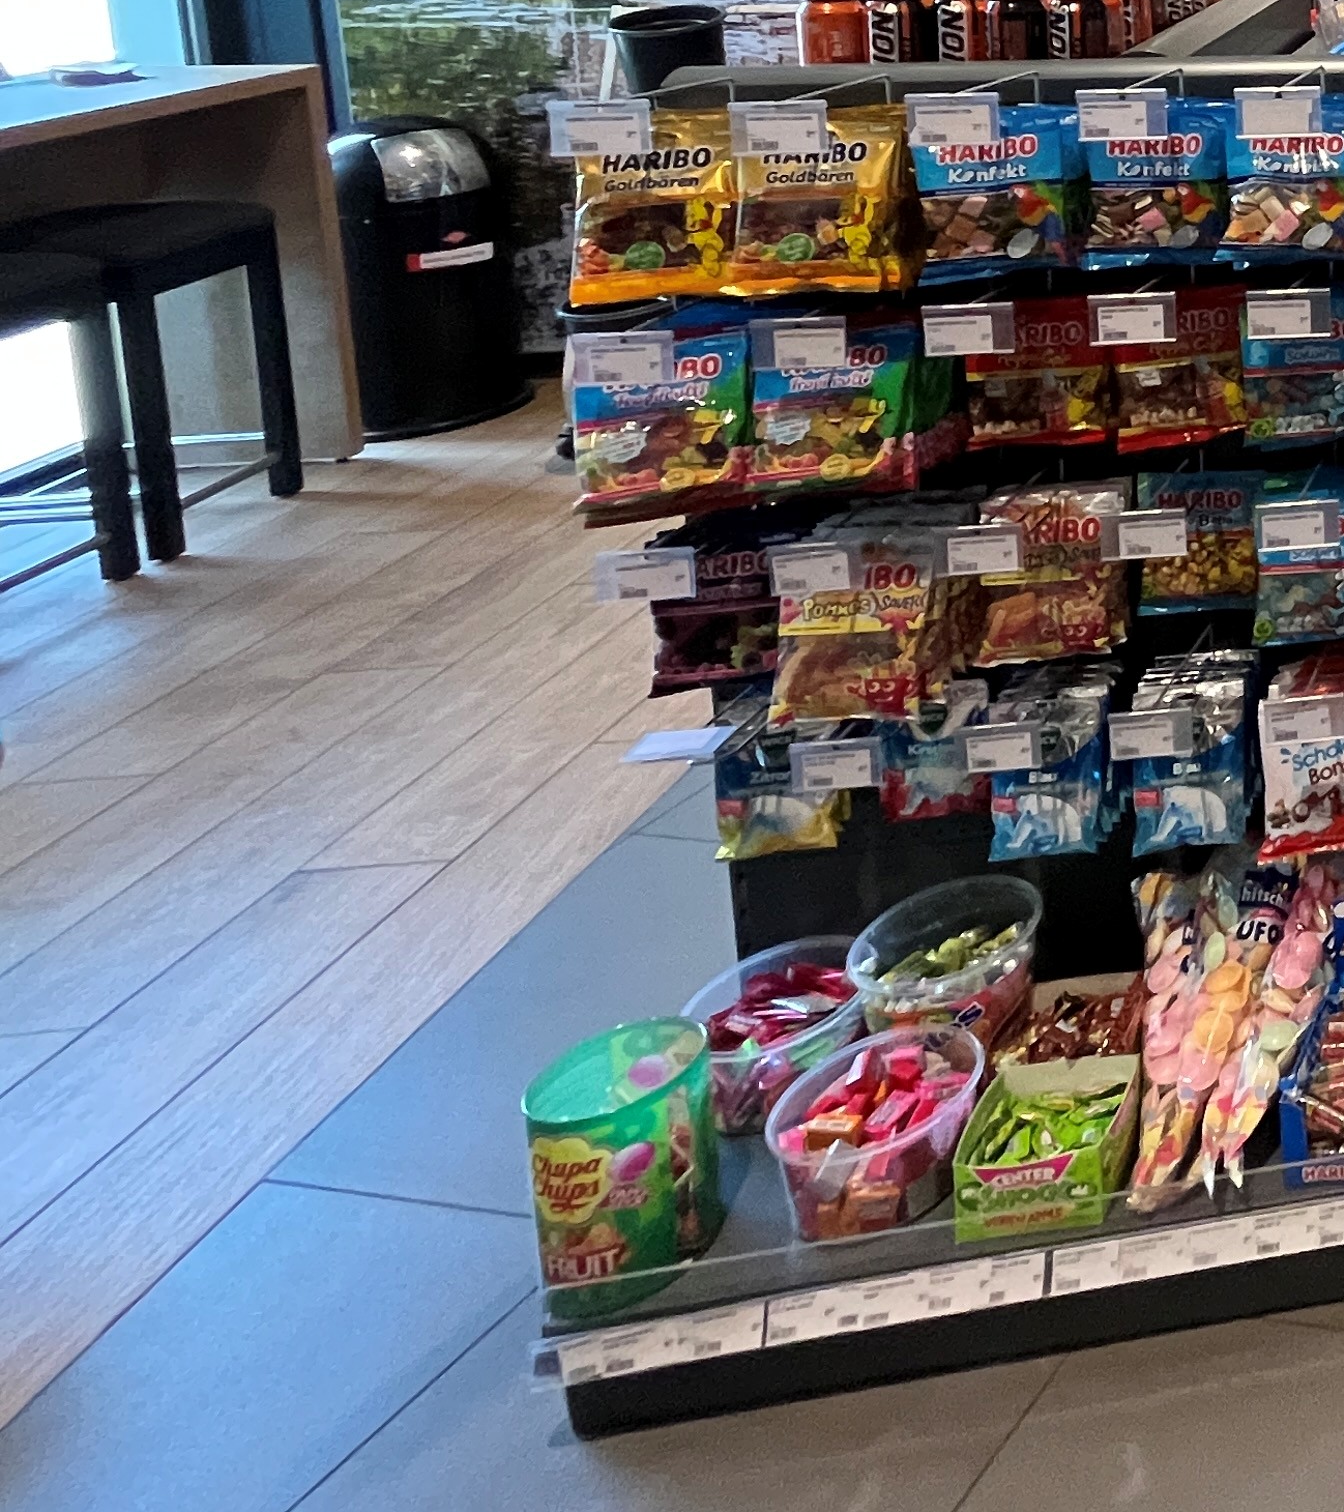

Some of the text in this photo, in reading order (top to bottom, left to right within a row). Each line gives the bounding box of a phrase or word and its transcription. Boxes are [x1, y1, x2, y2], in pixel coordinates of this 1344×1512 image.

[936, 133, 1038, 166] HARIBO
[1106, 133, 1203, 158] HARIBO
[602, 146, 712, 175] HARIBO
[946, 163, 1028, 185] Konfekt
[1115, 159, 1191, 179] Konfekt
[765, 170, 855, 185] Goldbären
[696, 550, 768, 580] ARIBO
[1240, 884, 1285, 907] hitsch
[532, 1153, 605, 1184] Chupa
[991, 1166, 1057, 1187] CENTER
[532, 1176, 601, 1214] Chups
[546, 1248, 621, 1281] FRUIT
